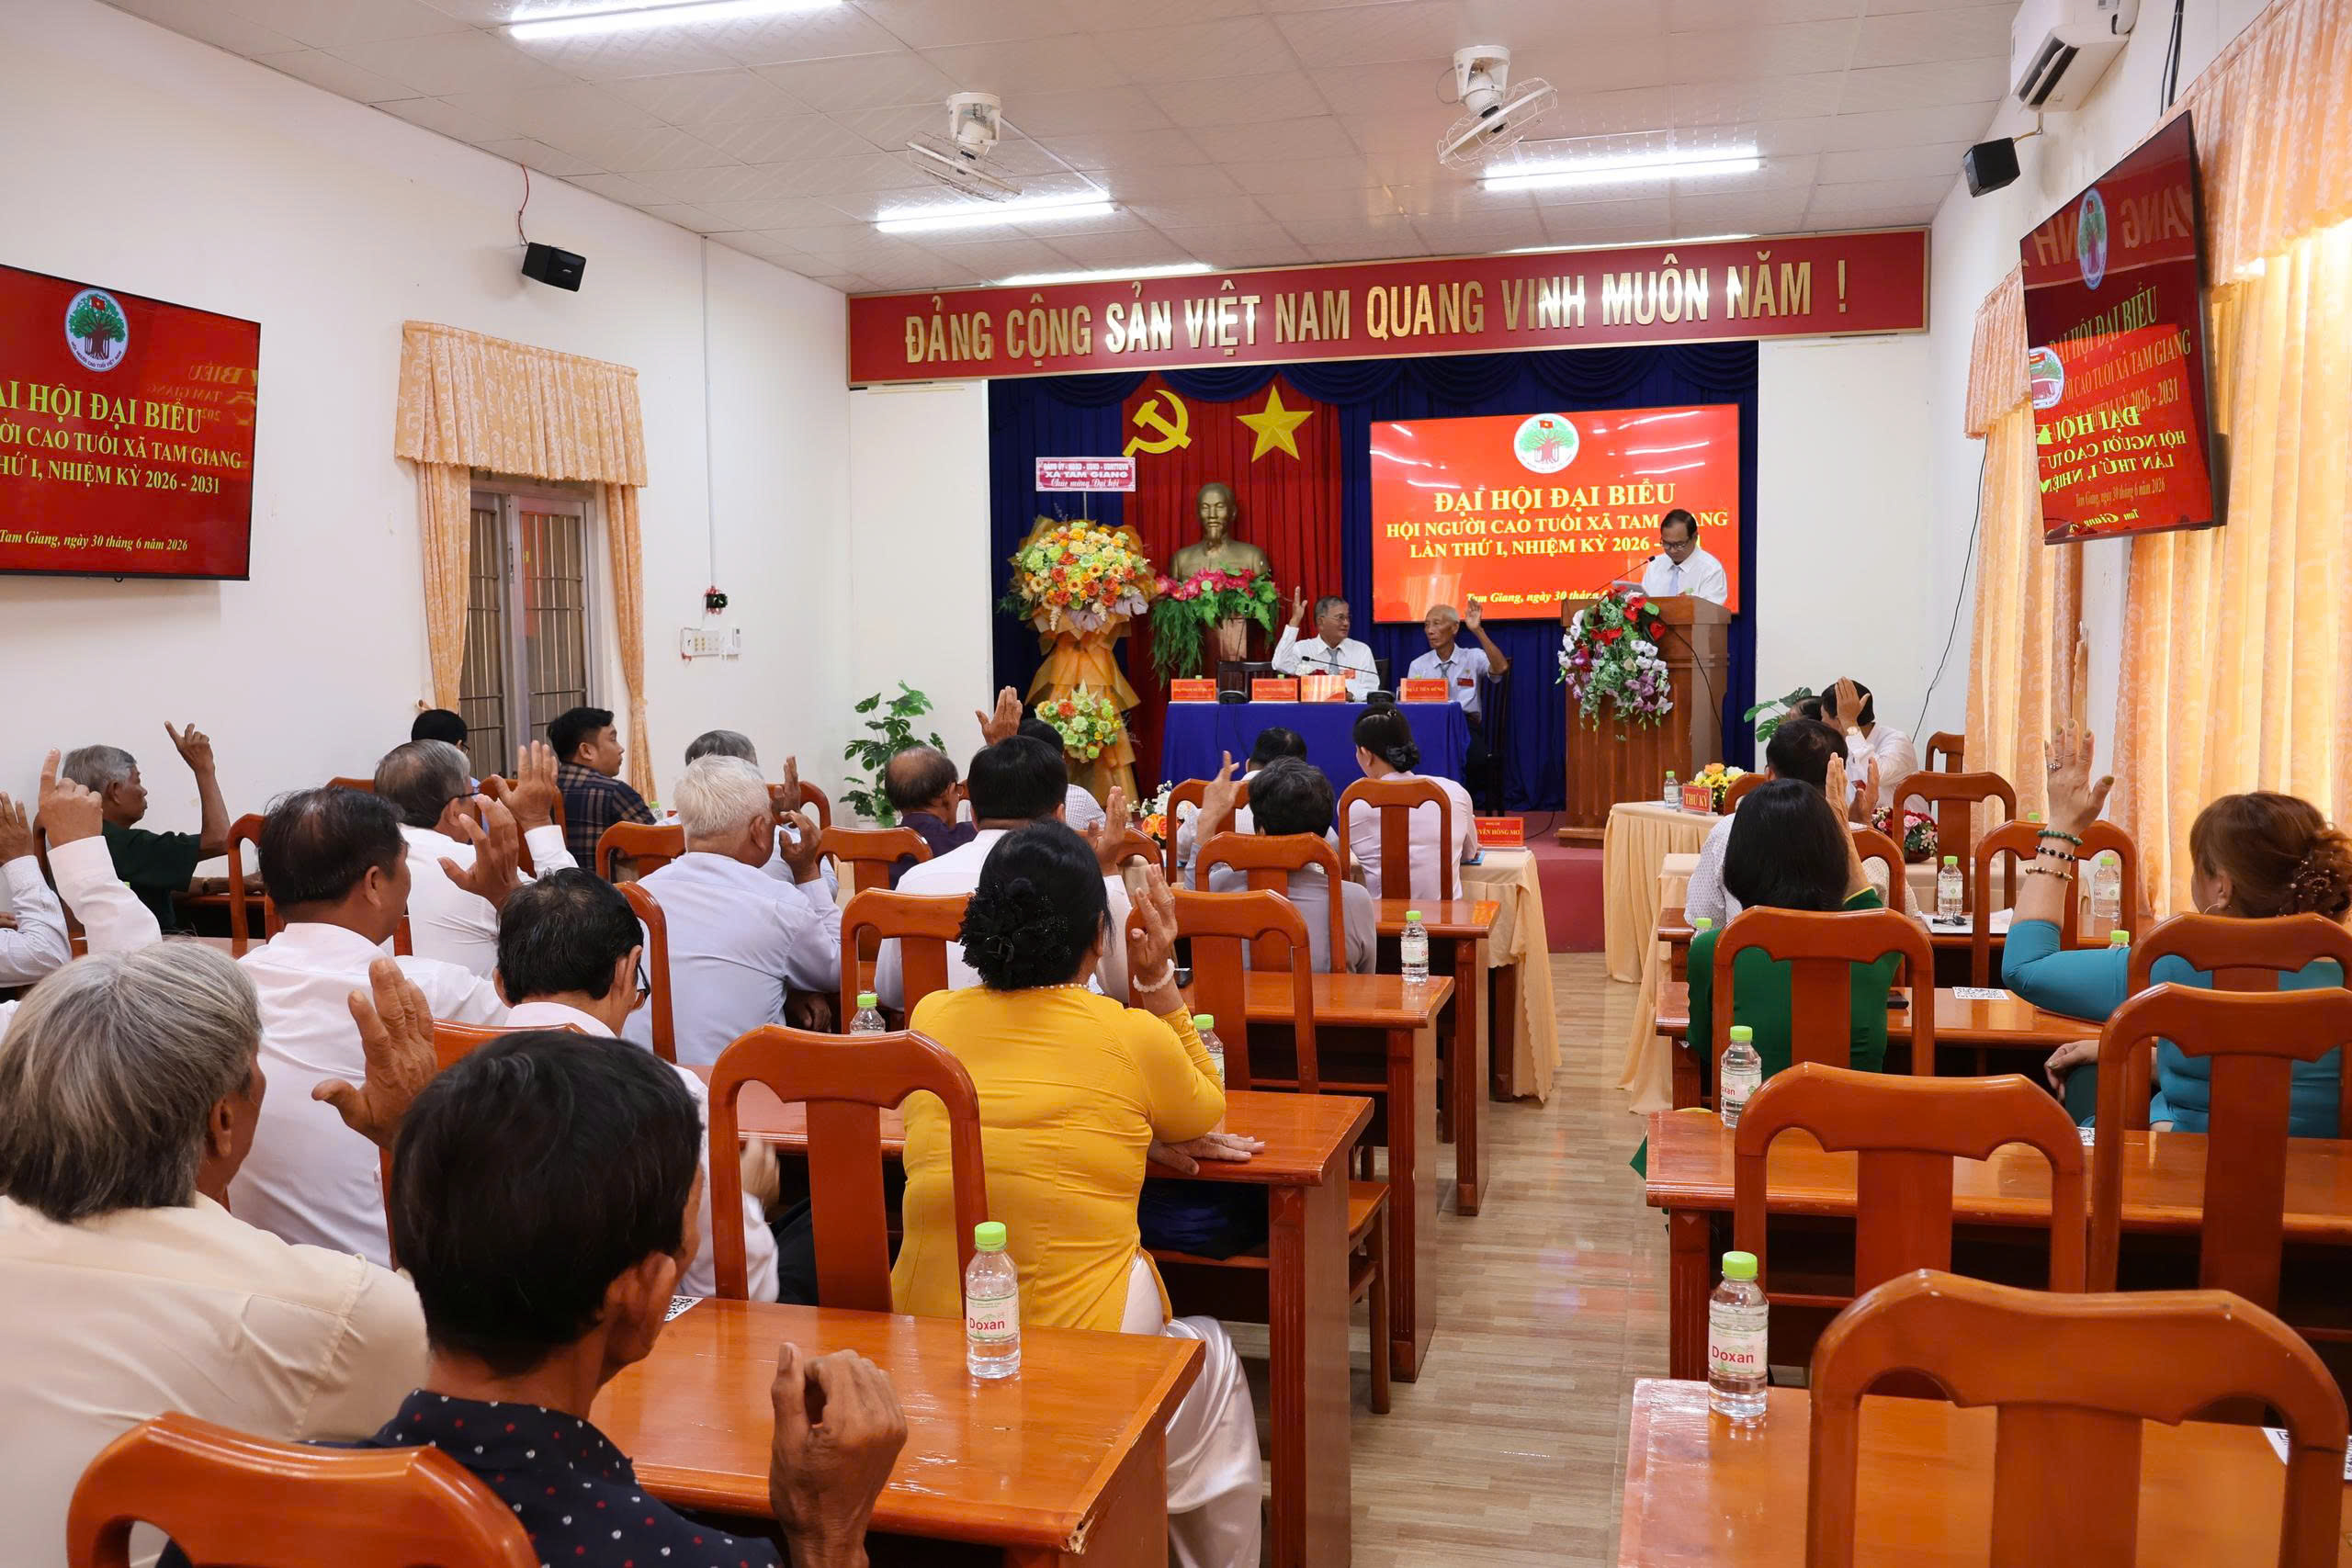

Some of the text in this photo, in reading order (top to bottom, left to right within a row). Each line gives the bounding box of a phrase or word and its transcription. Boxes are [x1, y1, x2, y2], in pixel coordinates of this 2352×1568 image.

[905, 250, 1848, 367] ĐẢNG CỘNG SẢN VIỆT NAM QUANG VINH MUÔN NĂM !
[2071, 319, 2094, 363] HỘI
[2095, 306, 2120, 352] ĐẠI
[2075, 372, 2092, 398] CAO
[2130, 344, 2153, 374] TAM
[2154, 329, 2191, 366] GIANG
[2158, 376, 2179, 406] 2031
[28, 383, 83, 423] HỘI
[90, 393, 138, 430] ĐẠI
[144, 399, 202, 434] BIỂU
[27, 426, 69, 449] CAO
[74, 431, 119, 455] TUỔI
[123, 436, 147, 458] XÃ
[152, 442, 187, 462] TAM
[191, 447, 242, 468] GIANG
[0, 451, 28, 476] HỨ
[30, 458, 42, 481] I,
[49, 460, 111, 488] NHIỆM
[117, 464, 141, 487] KỲ
[145, 470, 177, 491] 2026
[190, 475, 220, 493] 2031
[1434, 479, 1676, 516] ĐẠI HỘI ĐẠI BIỂU
[0, 529, 188, 551] Tam Giang, ngày 30 tháng 6 năm 2026
[1386, 513, 1659, 540] HỘI NGƯỜI CAO TUỔI XÃ TAM
[1452, 538, 1493, 557] THỨ
[1497, 541, 1508, 558] I,
[1512, 536, 1576, 558] NHIỆM
[1580, 534, 1609, 552] KỲ
[1612, 536, 1650, 551] 2026
[1490, 592, 1523, 604] Giang,
[1526, 591, 1551, 604] ngày
[1555, 591, 1566, 601] 30
[969, 1317, 1005, 1330] Doxan
[1712, 1346, 1754, 1364] Doxan
